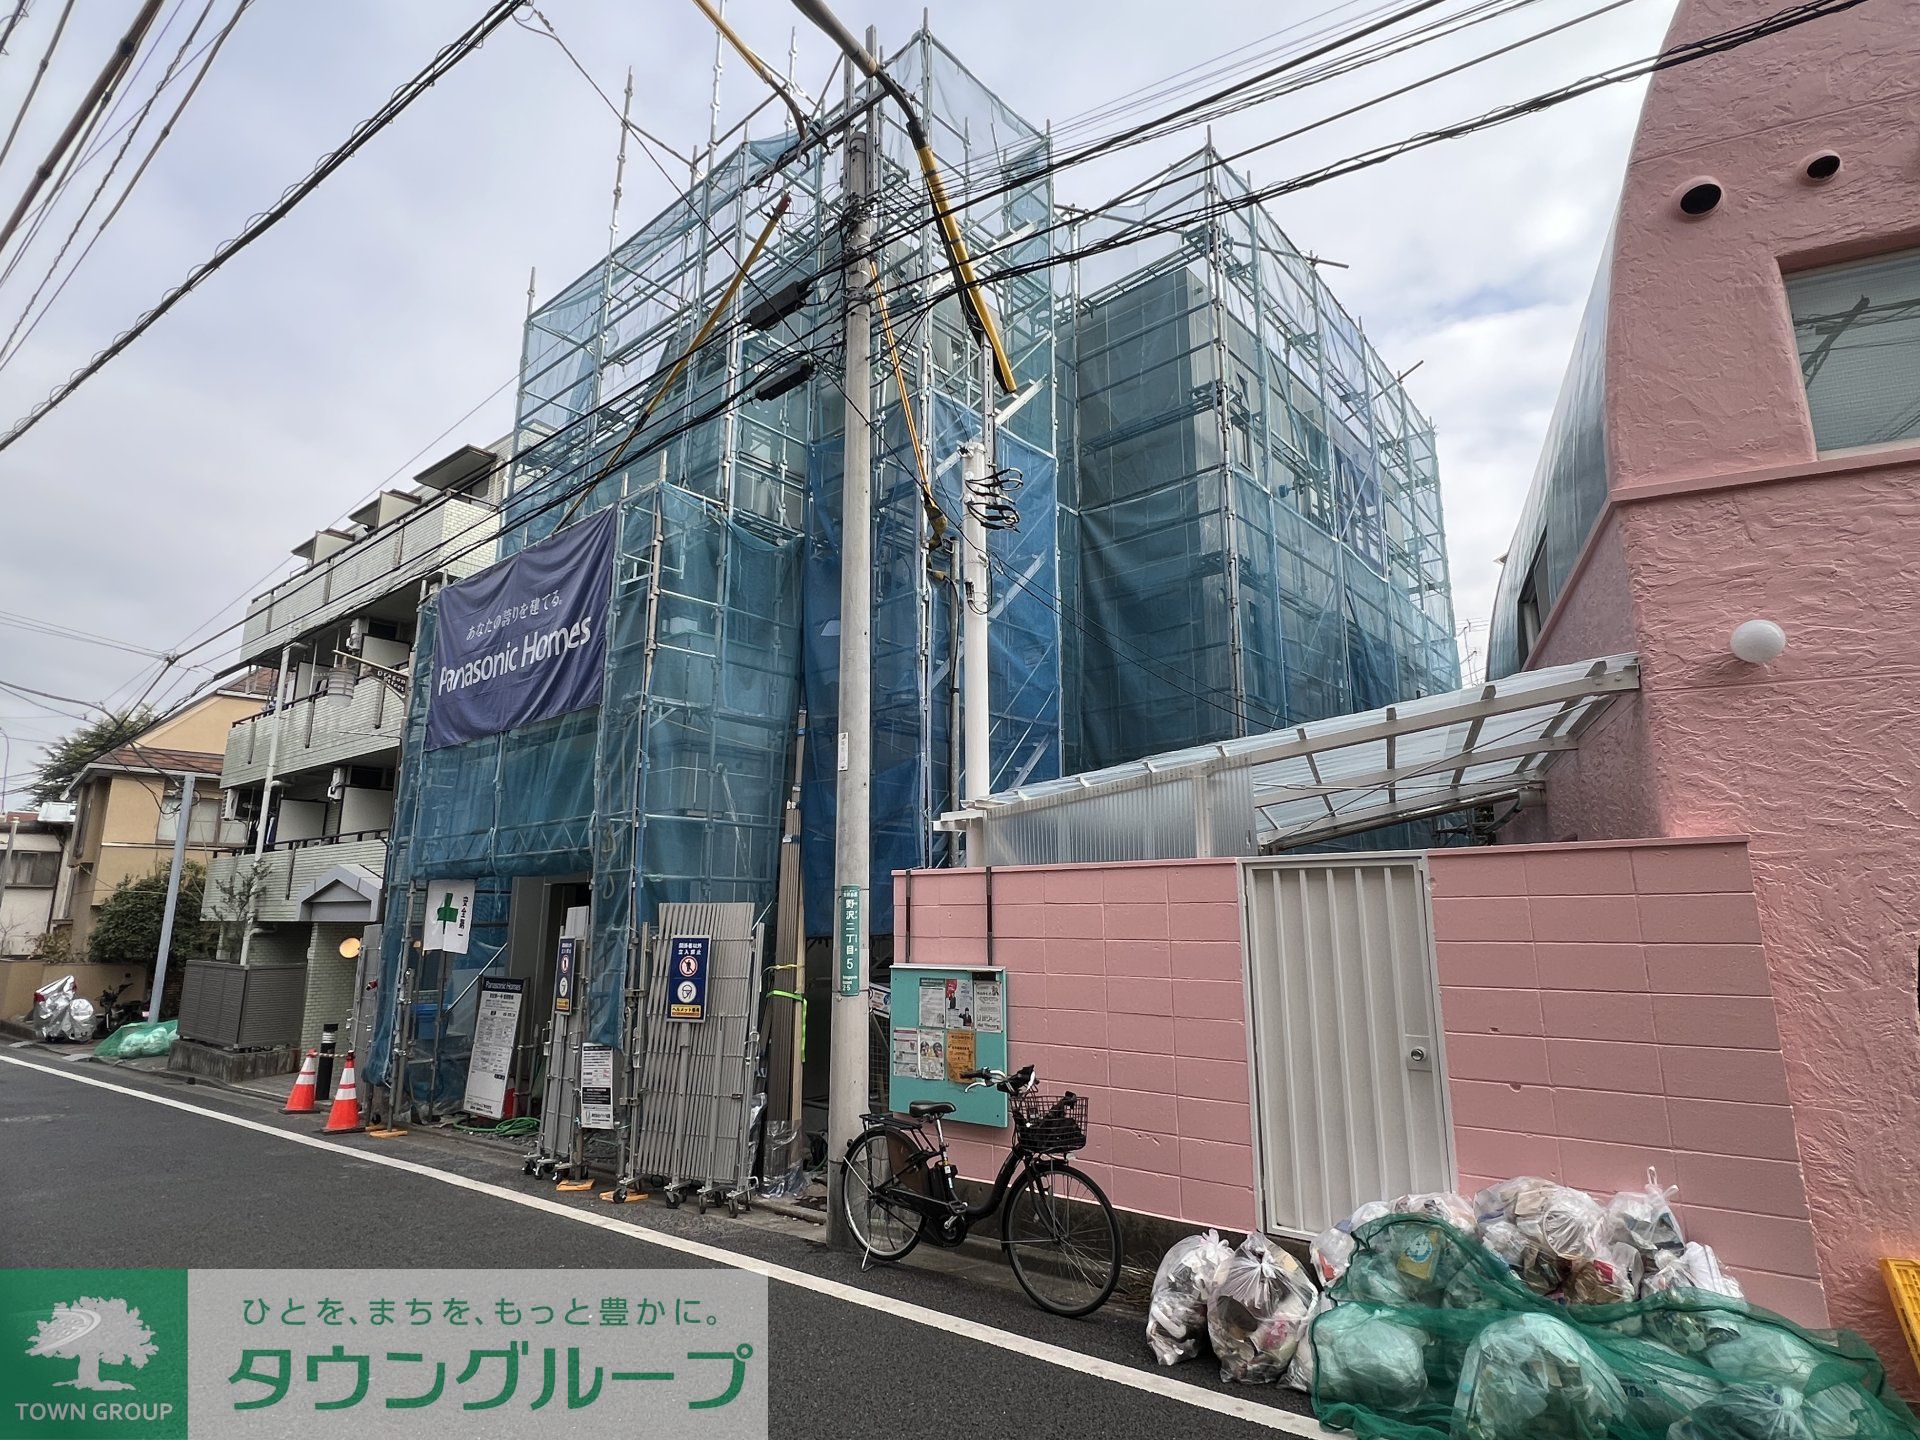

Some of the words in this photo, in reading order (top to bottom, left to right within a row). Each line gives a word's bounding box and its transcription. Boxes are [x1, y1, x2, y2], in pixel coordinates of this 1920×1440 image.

[466, 589, 562, 641] あなたの誇りを建てる。
[377, 670, 406, 685] Dragon
[438, 641, 518, 696] Panasonic
[520, 615, 592, 667] Homes
